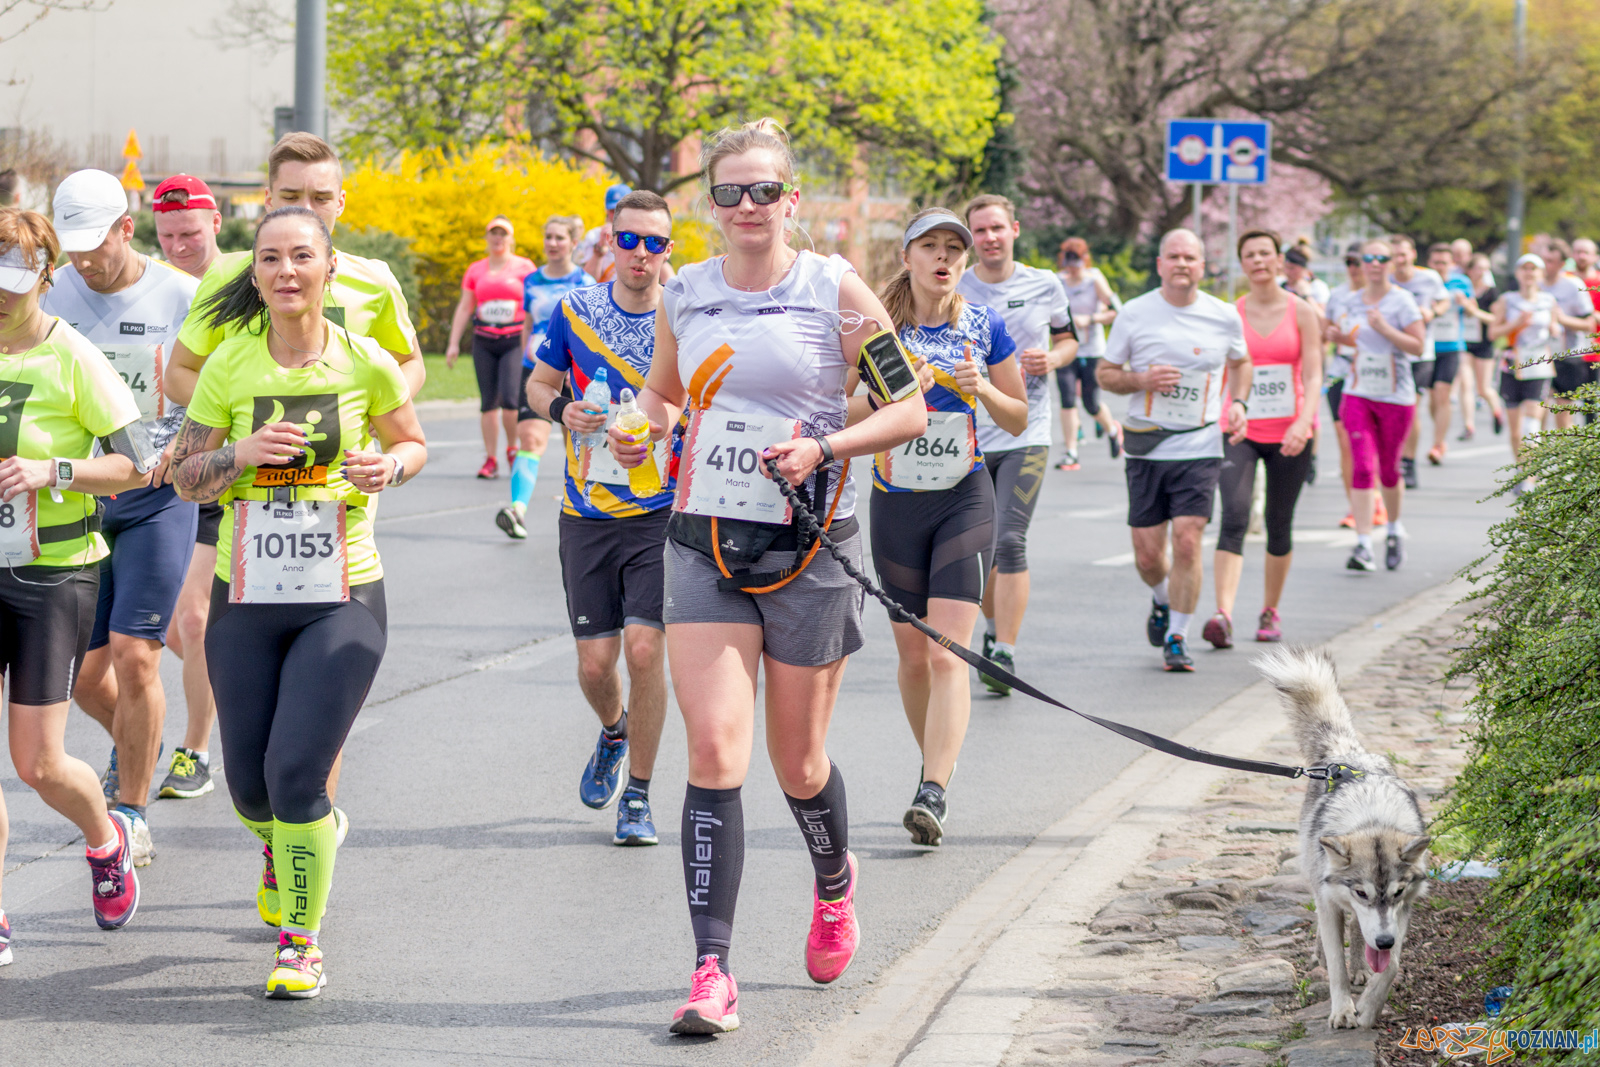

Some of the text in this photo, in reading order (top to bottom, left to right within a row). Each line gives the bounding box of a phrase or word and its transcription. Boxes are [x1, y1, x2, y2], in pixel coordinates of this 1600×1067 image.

[706, 445, 764, 475] 410
[725, 478, 750, 488] Marta
[253, 532, 334, 558] 10153
